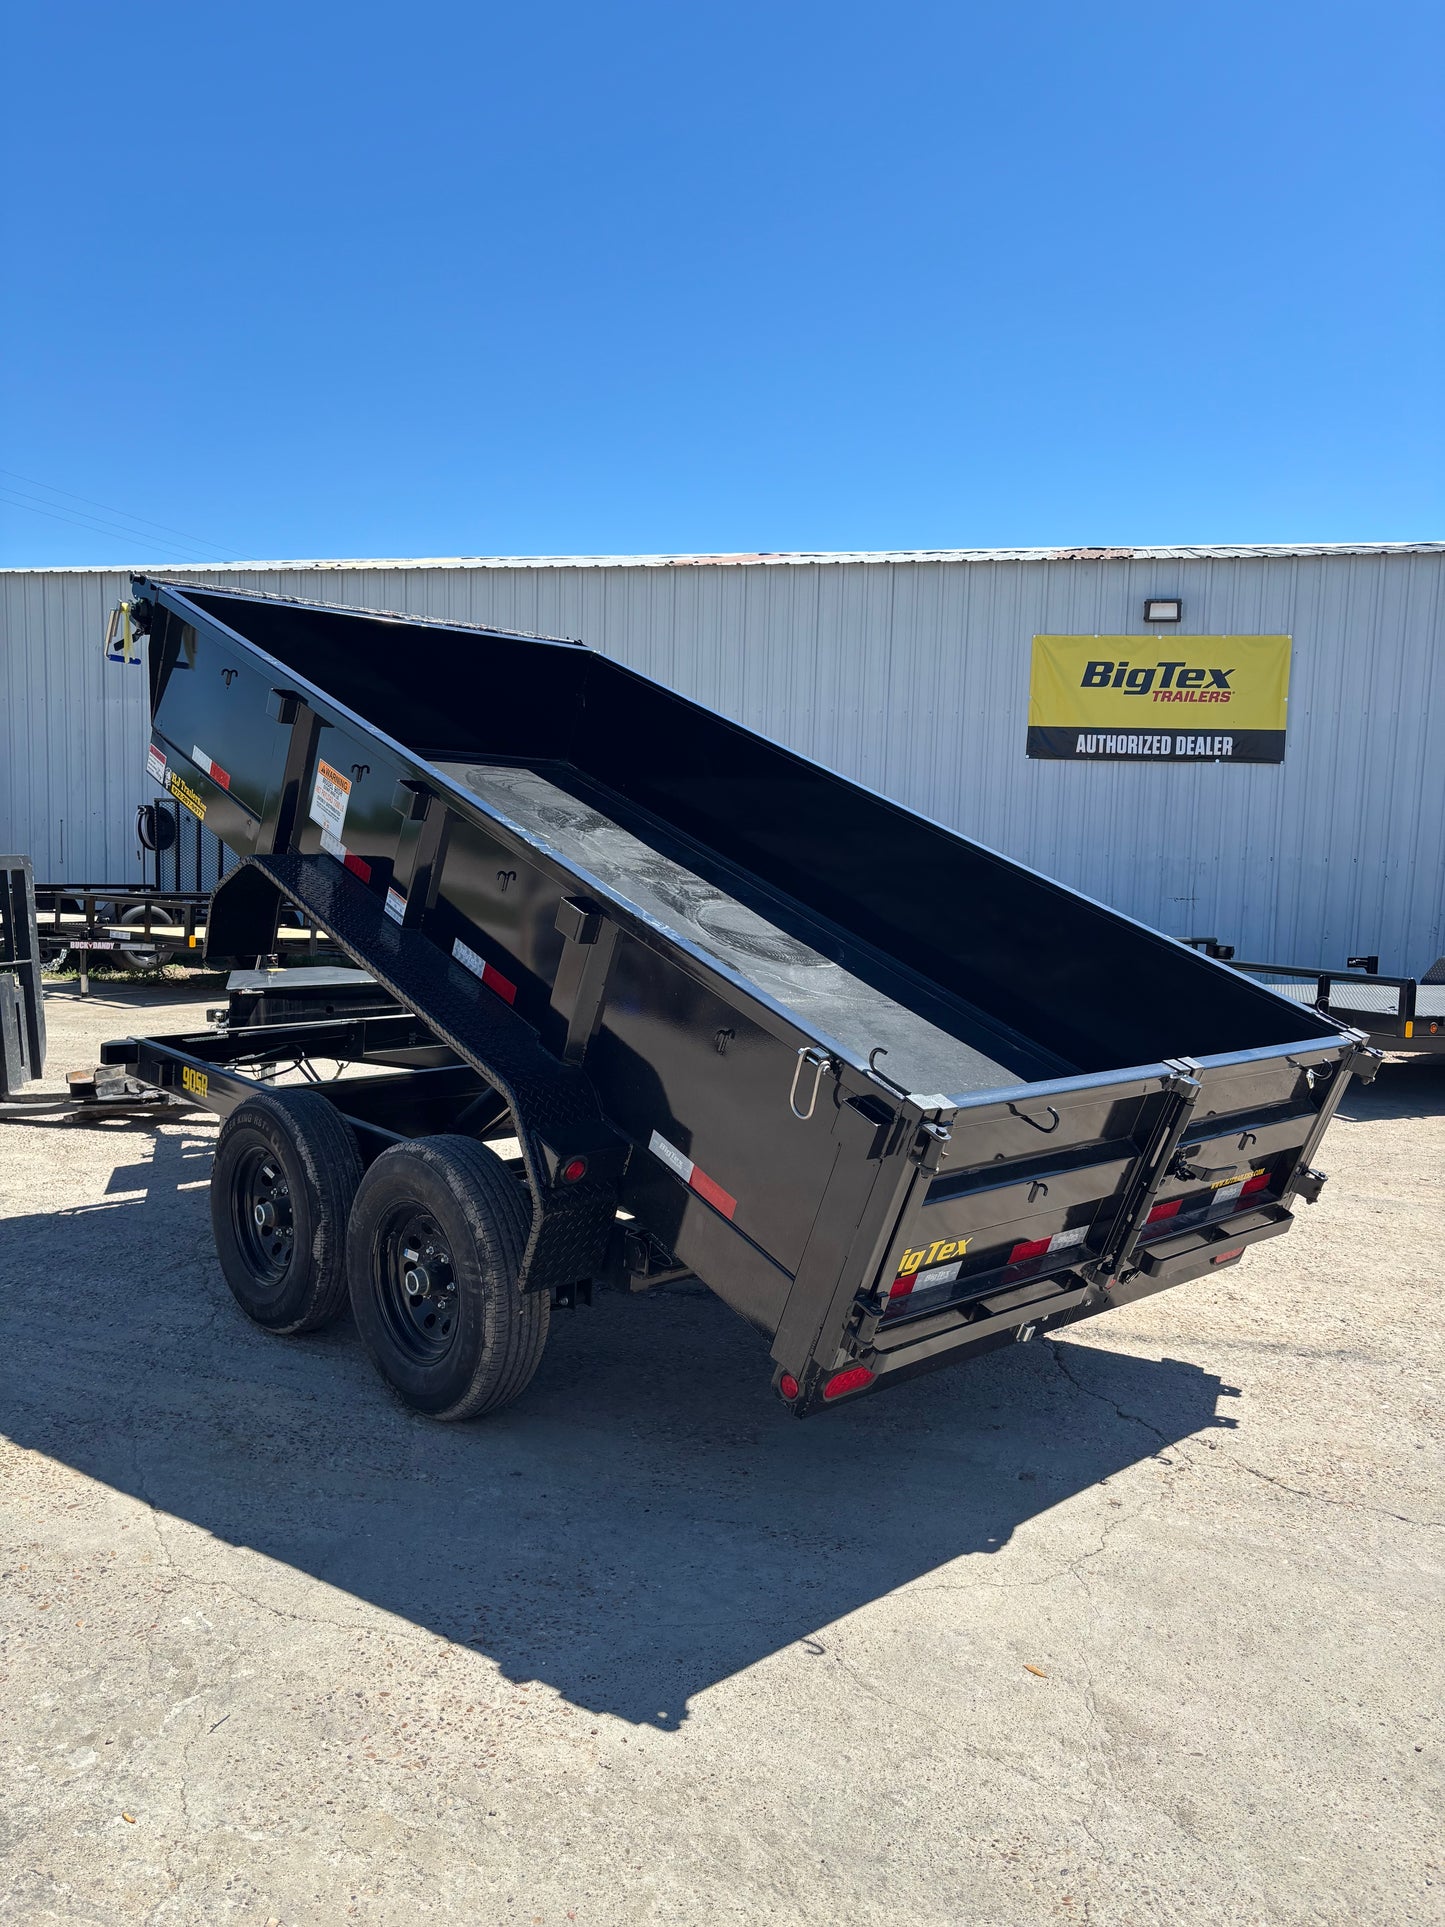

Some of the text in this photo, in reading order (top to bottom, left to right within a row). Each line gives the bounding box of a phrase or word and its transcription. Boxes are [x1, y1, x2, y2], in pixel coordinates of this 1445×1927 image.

[1080, 661, 1236, 695] BigTex
[1152, 690, 1232, 703] TRAILERS
[1075, 734, 1234, 756] AUTHORIZED DEALER
[325, 767, 348, 791] WARNING
[70, 941, 89, 949] BUCK
[93, 942, 115, 950] DANDY
[182, 1066, 208, 1098] 90SR
[897, 1237, 974, 1277] igTex
